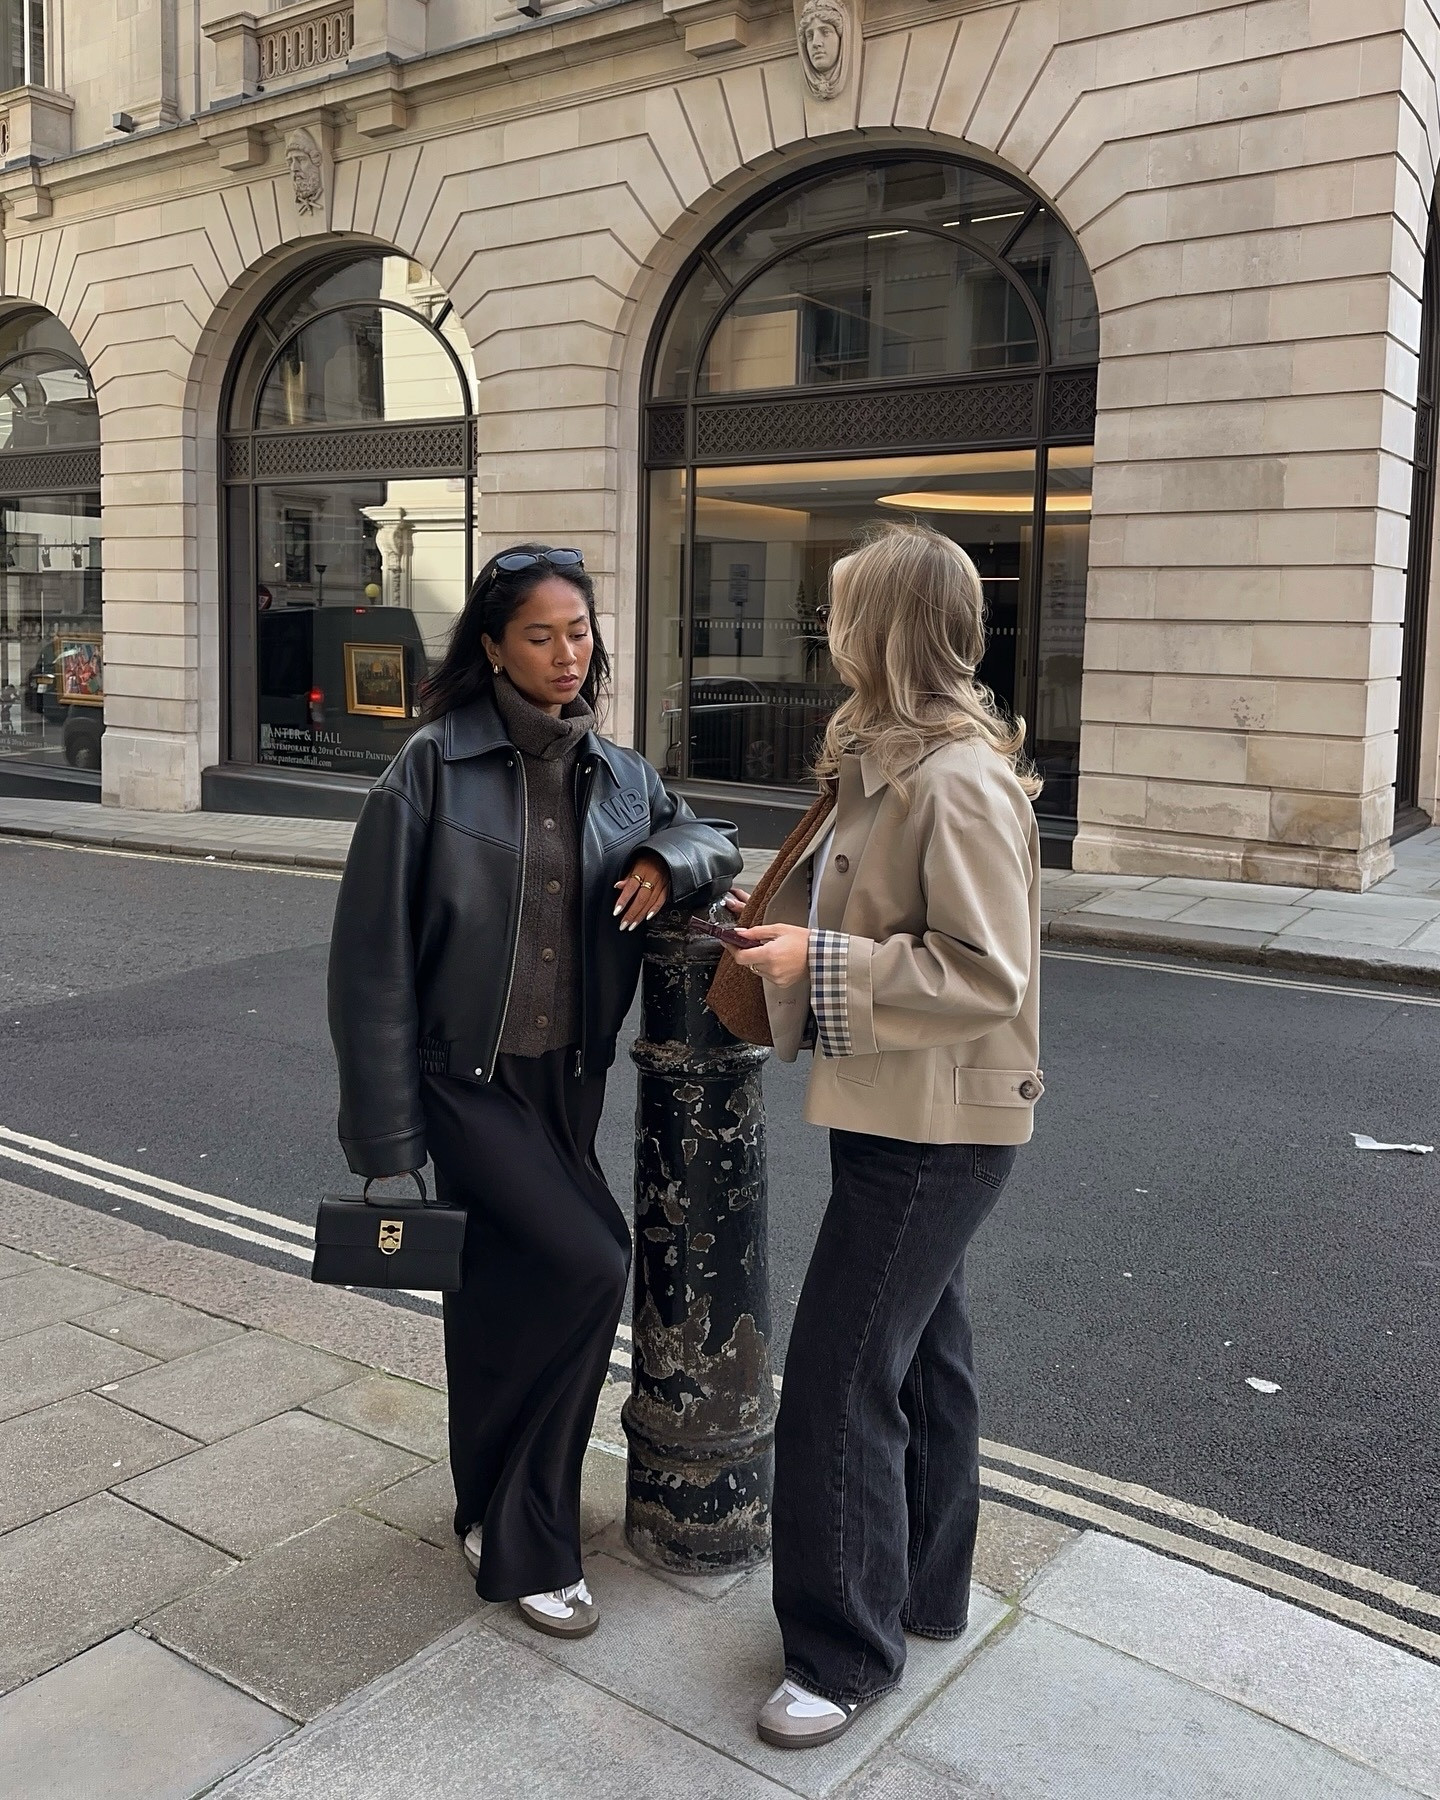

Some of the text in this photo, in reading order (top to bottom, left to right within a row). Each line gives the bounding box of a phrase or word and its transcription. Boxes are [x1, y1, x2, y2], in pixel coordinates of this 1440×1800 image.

[262, 725, 342, 744] PANTER & HALL
[311, 745, 317, 754] &
[262, 754, 332, 768] www.panterandhall.com
